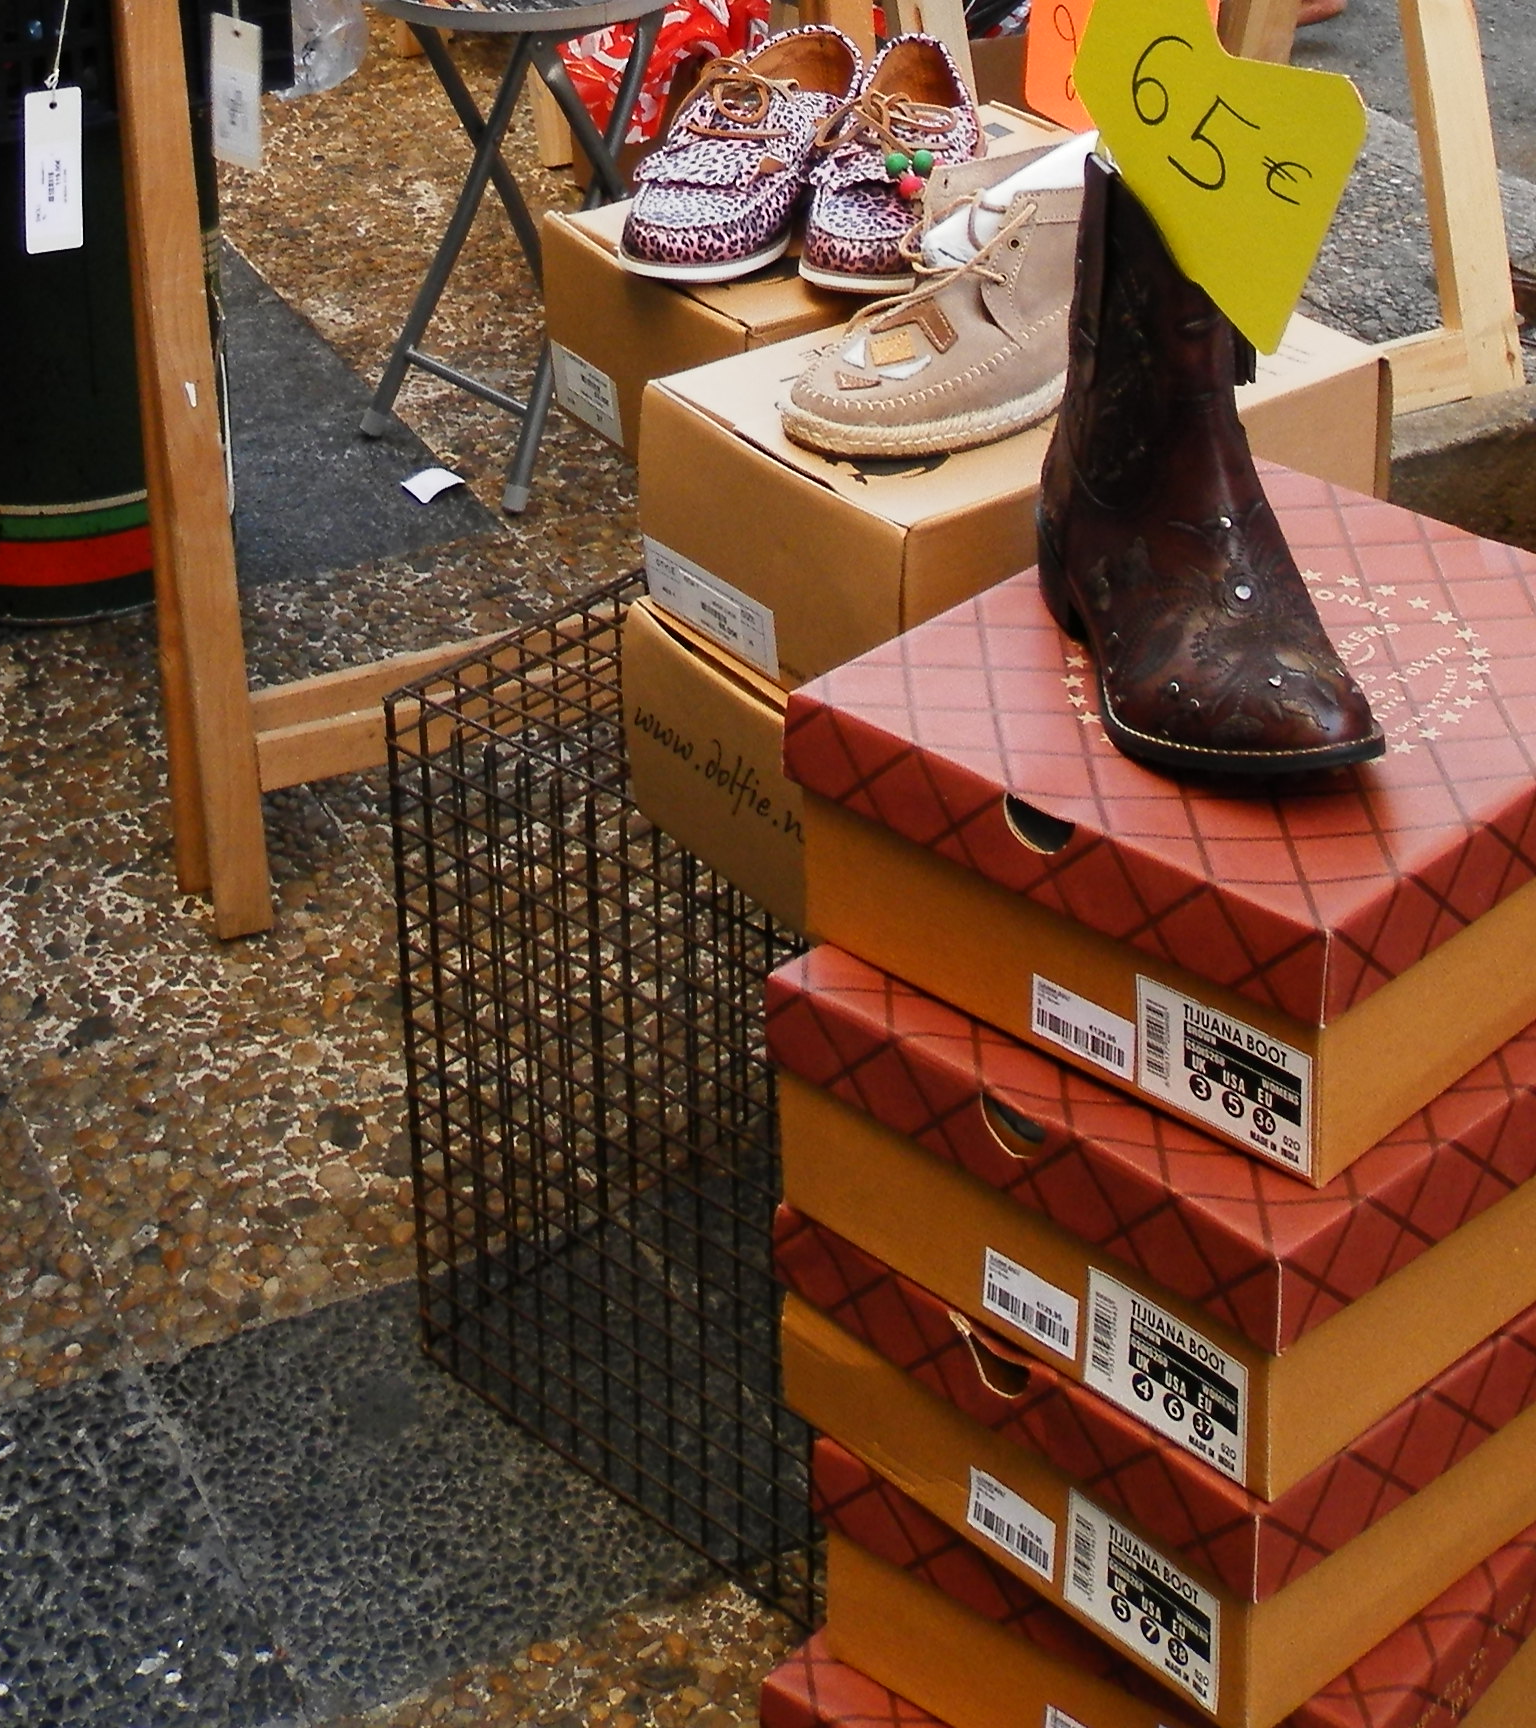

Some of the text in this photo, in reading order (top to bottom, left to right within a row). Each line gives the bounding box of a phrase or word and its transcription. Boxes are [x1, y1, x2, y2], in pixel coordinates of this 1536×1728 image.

[1183, 1003, 1286, 1069] TIJUANA BOOT
[1191, 1053, 1272, 1109] UK USA EU
[1261, 1078, 1299, 1106] WOMENS
[1131, 1298, 1225, 1376] TIJUANA BOOT
[1136, 1351, 1212, 1415] UK USA EU
[1108, 1523, 1198, 1606] TIJUANA BOOT
[1114, 1574, 1185, 1641] UK USA EU
